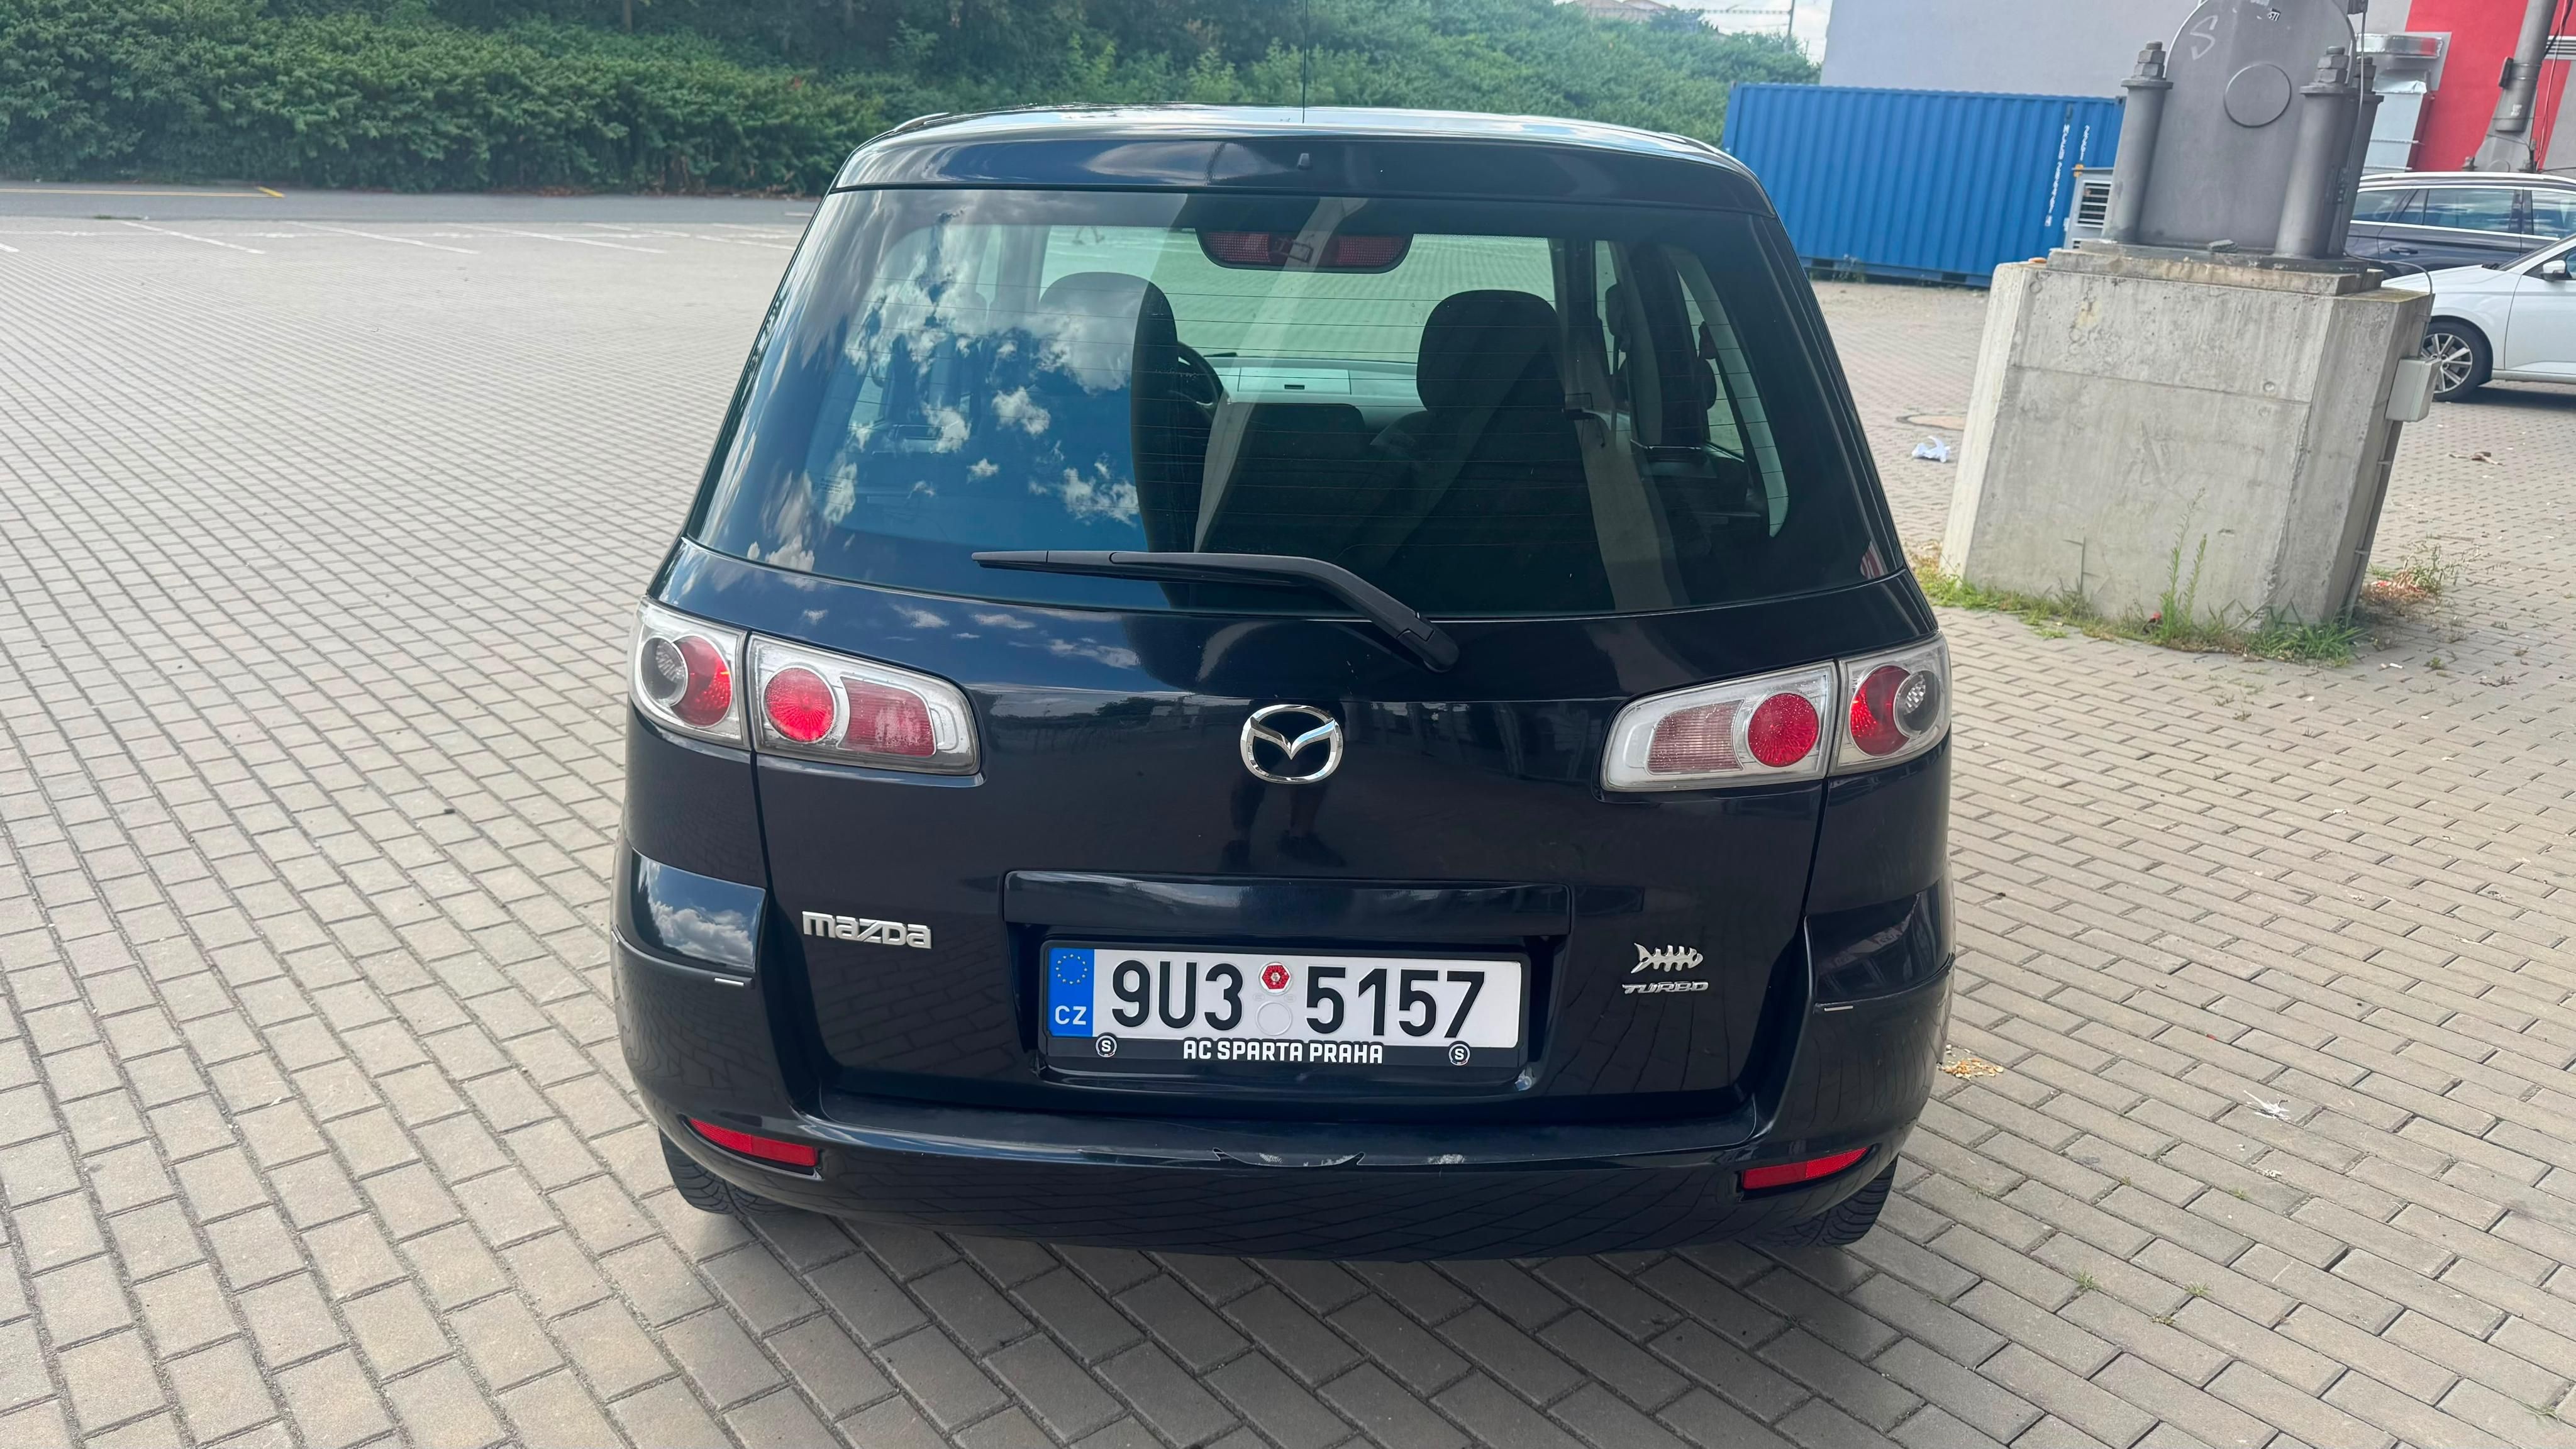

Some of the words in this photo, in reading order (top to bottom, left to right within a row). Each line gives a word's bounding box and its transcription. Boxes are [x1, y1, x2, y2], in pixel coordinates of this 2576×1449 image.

[1621, 981, 1709, 994] TURBO
[1111, 960, 1244, 1031] 9U3
[1306, 966, 1485, 1038] 5157
[1055, 1005, 1087, 1025] CZ
[1101, 1040, 1111, 1052] S
[1183, 1040, 1212, 1060] AC
[1217, 1041, 1303, 1062] SPARTA
[1309, 1043, 1383, 1064] PRAHA
[1455, 1048, 1465, 1060] S
